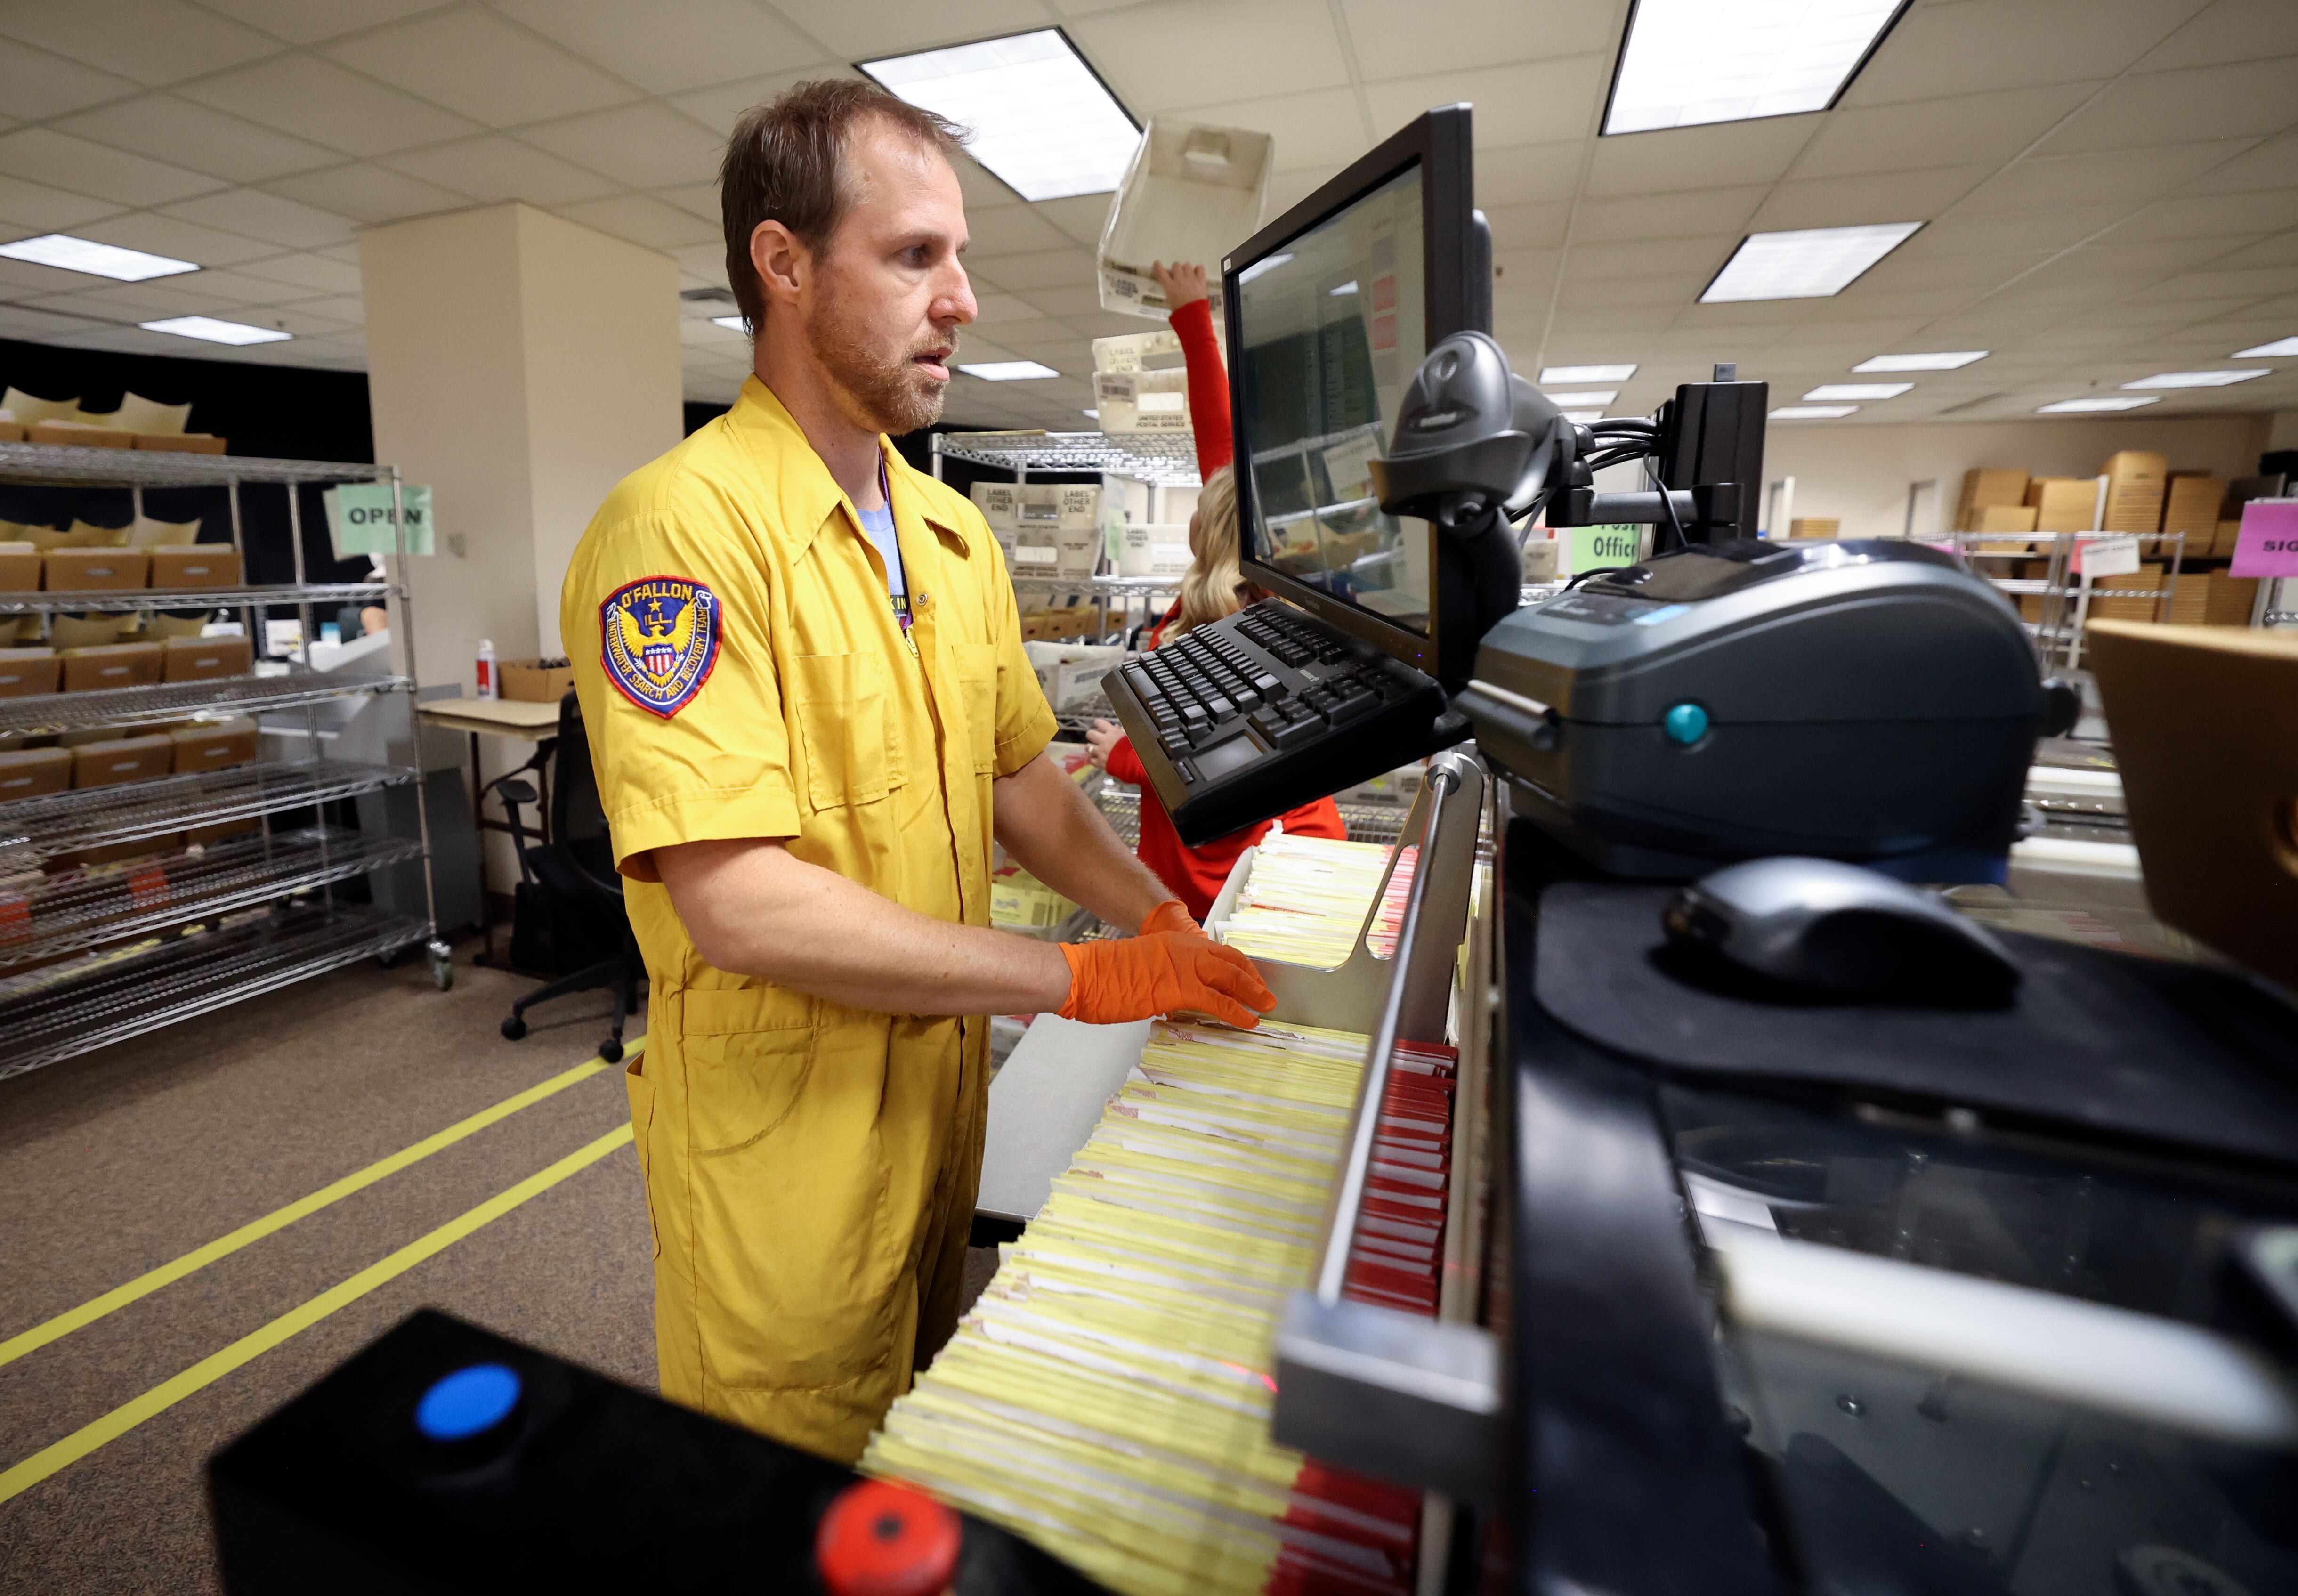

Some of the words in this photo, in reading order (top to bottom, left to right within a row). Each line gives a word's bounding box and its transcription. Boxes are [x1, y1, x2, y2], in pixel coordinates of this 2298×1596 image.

[349, 507, 423, 525] OPEN
[621, 582, 693, 608] O'FALLON
[644, 613, 672, 626] ILL.
[608, 619, 632, 676] UNDERWATER
[629, 674, 663, 700] SEARCH
[666, 680, 684, 699] AND
[680, 636, 706, 681] RECOVERY
[697, 609, 707, 633] TEAM
